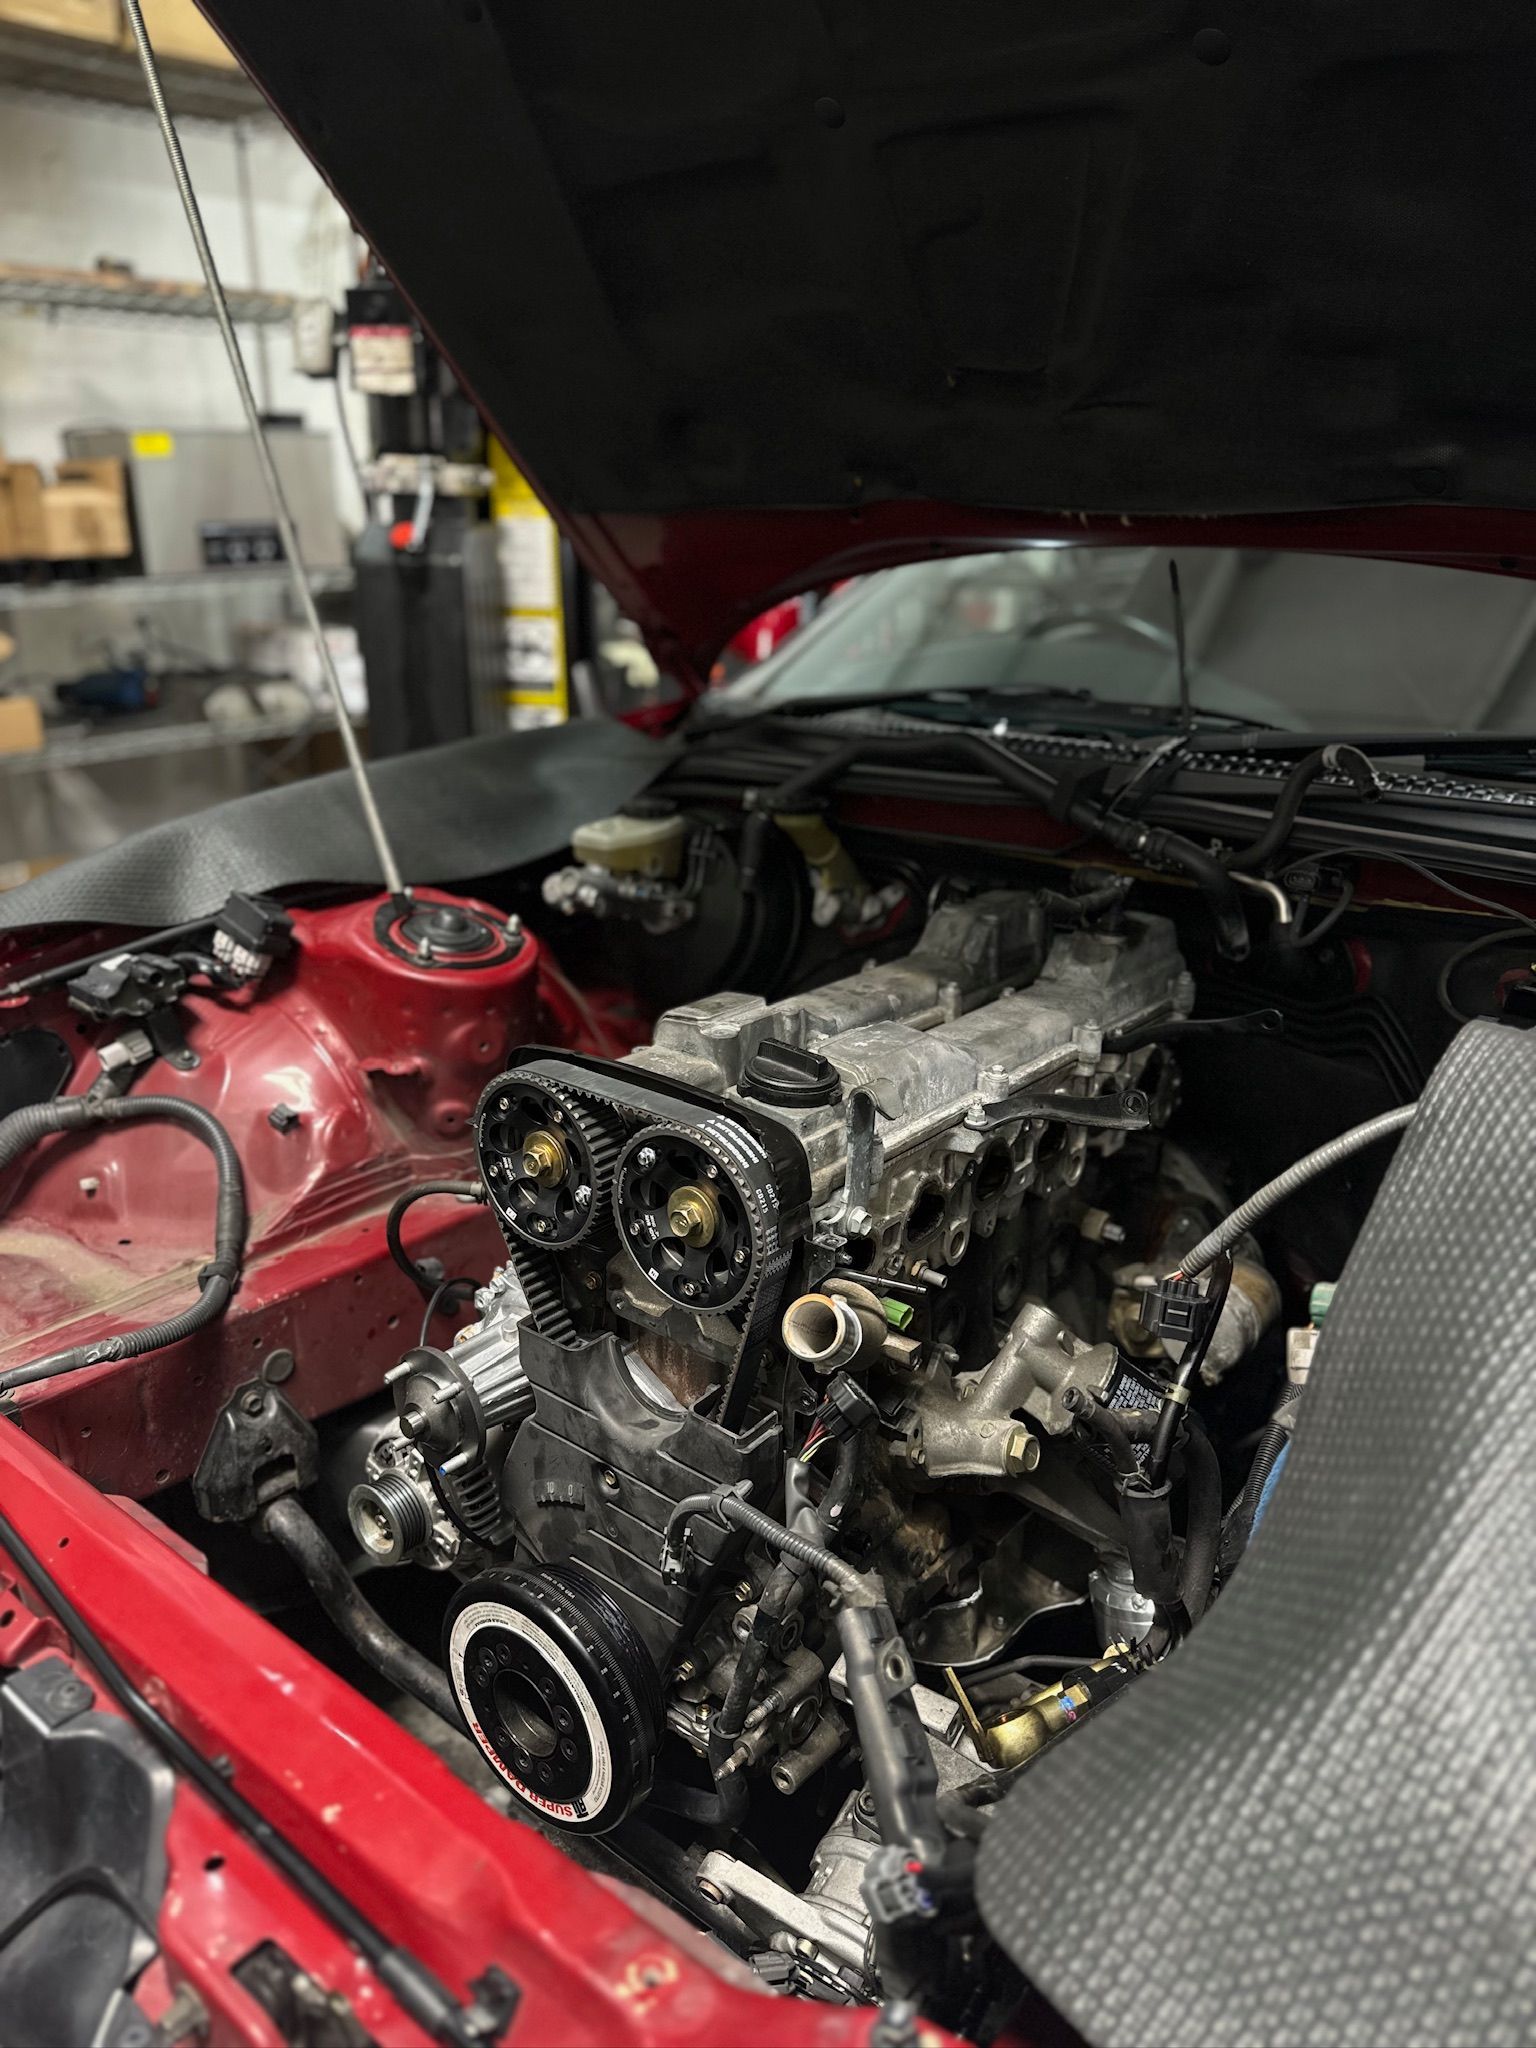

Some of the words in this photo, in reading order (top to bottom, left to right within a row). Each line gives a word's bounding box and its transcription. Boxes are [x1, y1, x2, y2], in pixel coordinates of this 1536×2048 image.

[704, 1126, 750, 1169] MITSUBOSHI
[715, 1122, 760, 1164] MITSUBOSHI
[755, 1188, 769, 1214] CD215
[472, 1721, 527, 1793] DAMPER
[529, 1791, 573, 1817] SUPER
